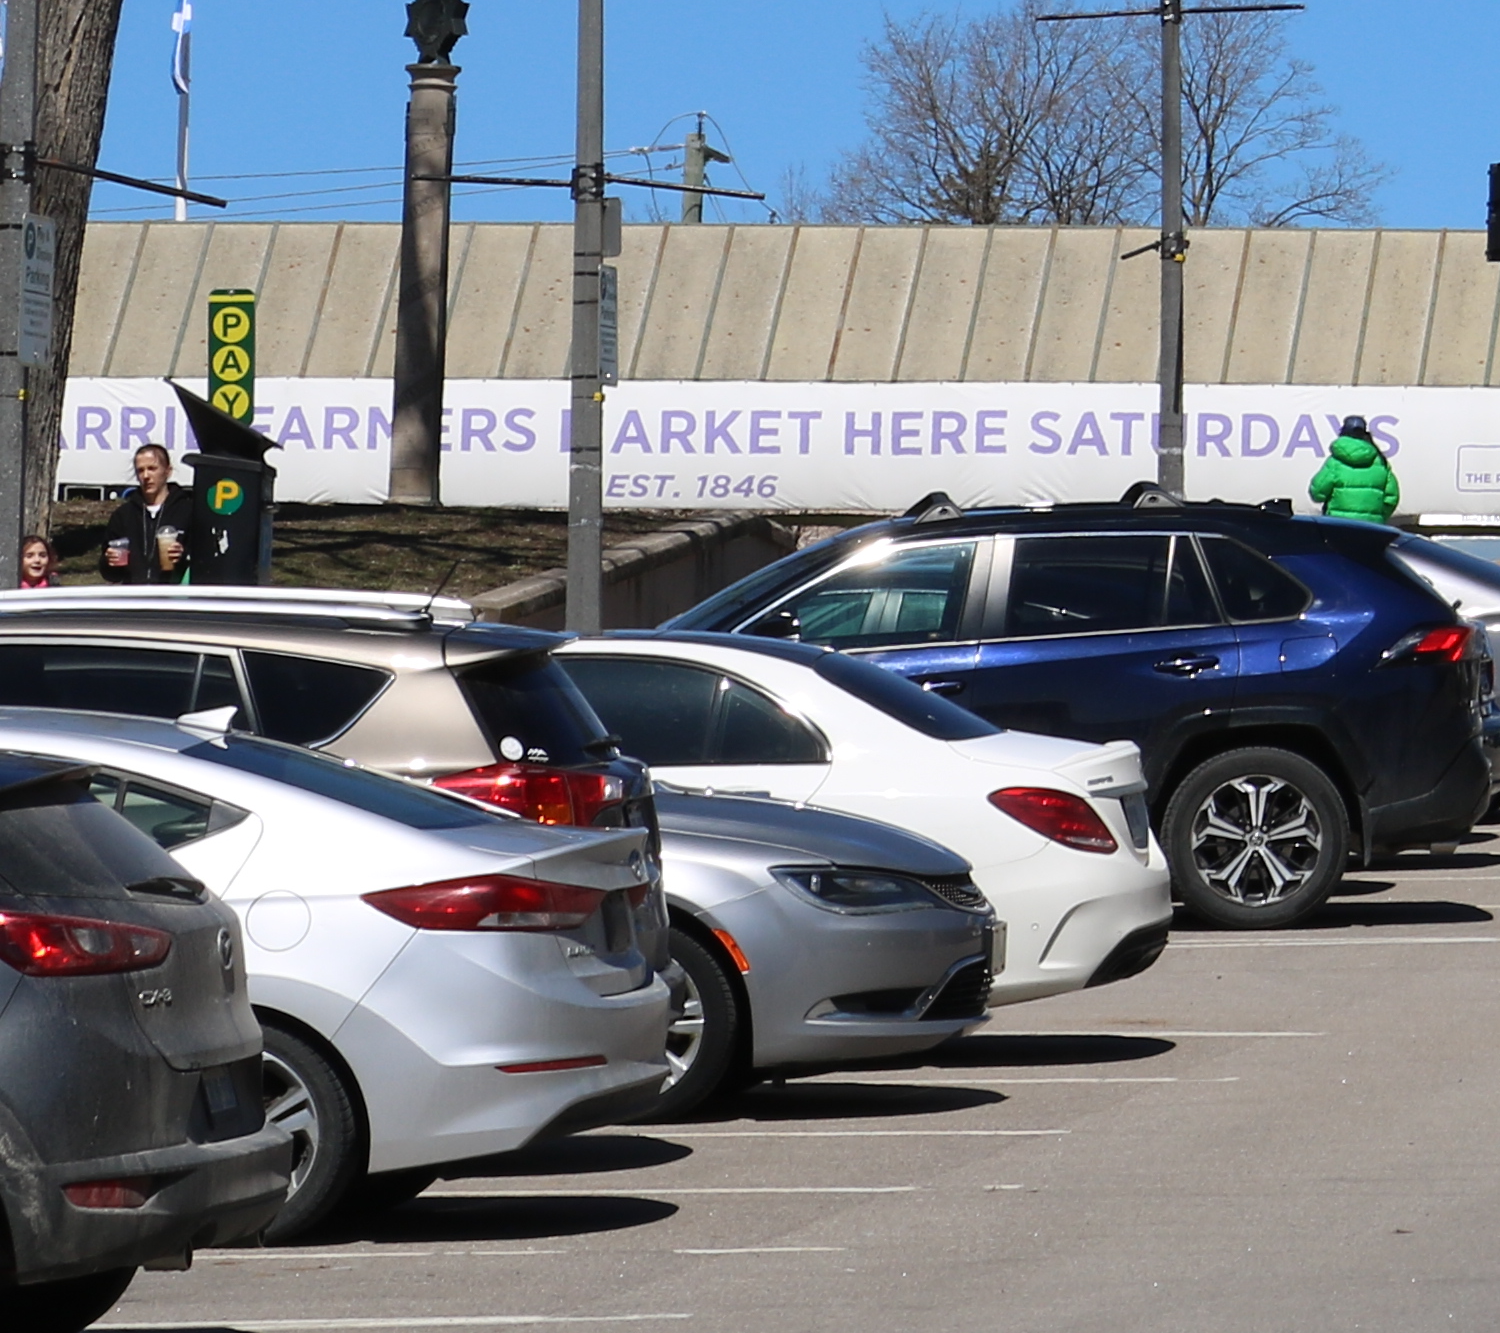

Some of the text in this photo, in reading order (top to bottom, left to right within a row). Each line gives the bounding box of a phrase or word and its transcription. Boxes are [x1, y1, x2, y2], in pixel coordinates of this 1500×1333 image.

[219, 313, 243, 416] PAY
[843, 410, 1009, 455] HERE
[1028, 411, 1400, 458] SATURDAS
[605, 475, 779, 499] EST. 1846
[1466, 473, 1491, 483] THE
[215, 480, 239, 510] P
